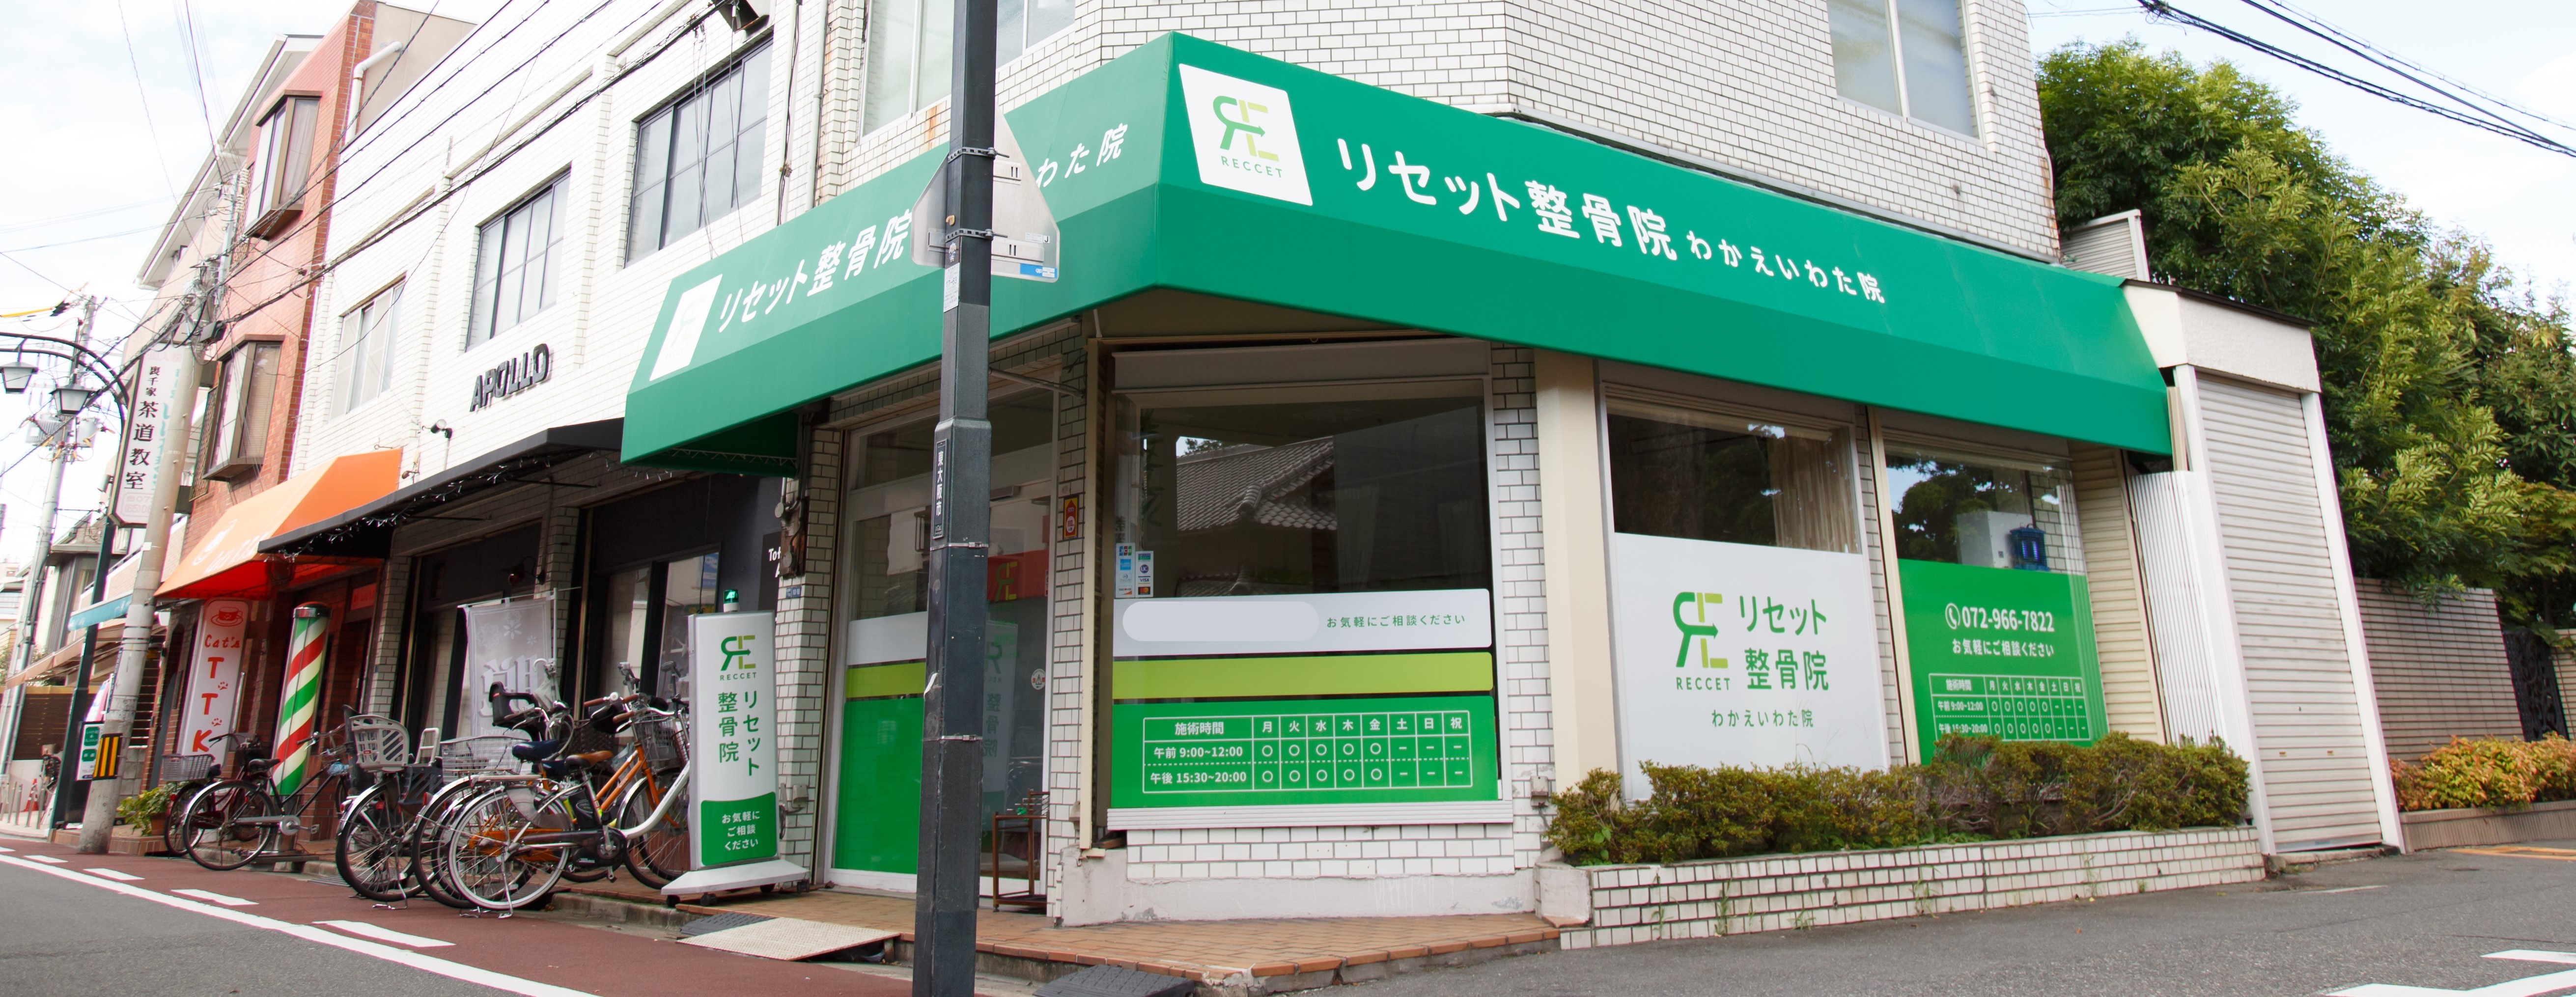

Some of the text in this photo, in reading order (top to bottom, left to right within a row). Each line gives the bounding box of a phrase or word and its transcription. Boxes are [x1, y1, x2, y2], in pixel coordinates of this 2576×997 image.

[1221, 156, 1283, 178] RECCET
[1337, 138, 1885, 304] リセット整骨院 わかえいわた院
[719, 209, 912, 332] リセット整骨院
[470, 343, 550, 412] APOLLO
[124, 366, 161, 490] 裏千家 茶道教室
[936, 450, 944, 516] 東大阪市
[768, 546, 781, 561] Tot
[1327, 614, 1465, 628] お気軽にご相談ください
[1739, 596, 1826, 636] リセット
[1961, 606, 2055, 633] 072-966-7822
[204, 634, 241, 648] Cat's
[1952, 638, 2054, 658] お気軽にご相談ください
[720, 672, 757, 681] RECCET
[1744, 648, 1829, 691] 整骨院
[1676, 677, 1730, 691] RECCET
[1946, 679, 2081, 692] 施術時間 月 火 水 木 金 土 日 祝
[1938, 701, 1950, 711] 午前
[718, 692, 739, 763] 整骨院
[1175, 717, 1462, 736] 施術時間 月 火 水 木 金 土 日 祝
[1711, 709, 1814, 728] わかえいわた院
[743, 691, 760, 776] リセット
[1154, 747, 1176, 759] 午前
[1150, 772, 1173, 784] 午後
[722, 811, 760, 824] お気軽に
[727, 824, 756, 837] ご相談
[725, 839, 758, 851] ください
